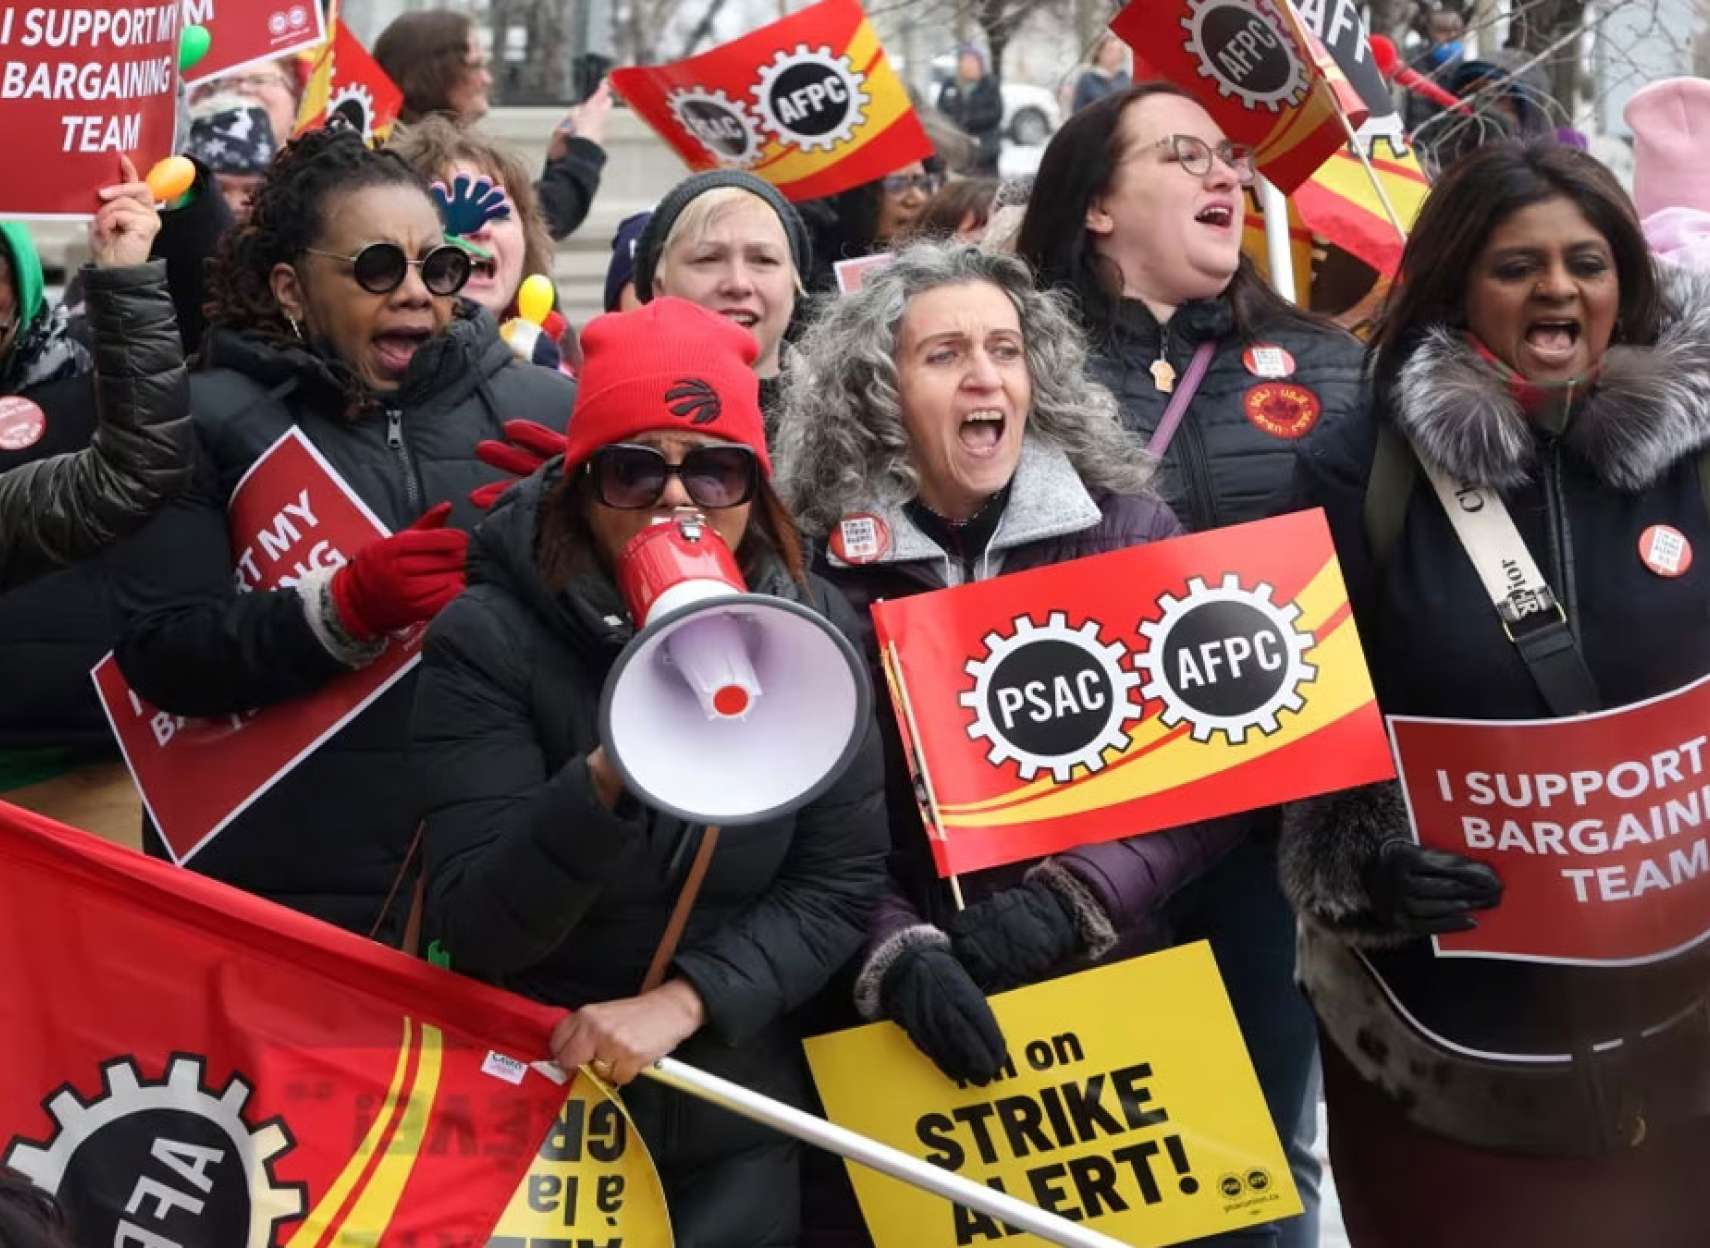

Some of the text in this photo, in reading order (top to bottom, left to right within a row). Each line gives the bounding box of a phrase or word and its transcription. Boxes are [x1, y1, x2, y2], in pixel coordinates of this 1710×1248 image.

[0, 3, 177, 47] I SUPPORT MY
[1215, 19, 1279, 82] AFPC
[1, 55, 172, 100] BARGAINING
[776, 74, 848, 125] AFPC
[61, 112, 141, 153] TEAM
[257, 488, 319, 562] MY
[1177, 628, 1283, 689] AFPC
[996, 669, 1106, 729] PSAC
[1436, 736, 1707, 808] I SUPPORT
[1461, 785, 1710, 856] BARGAINI
[1561, 838, 1710, 903] TEAM
[1025, 1031, 1084, 1071] on
[916, 1062, 1168, 1172] STRIKE
[527, 1175, 625, 1226] à la
[952, 1134, 1200, 1246] AERT!
